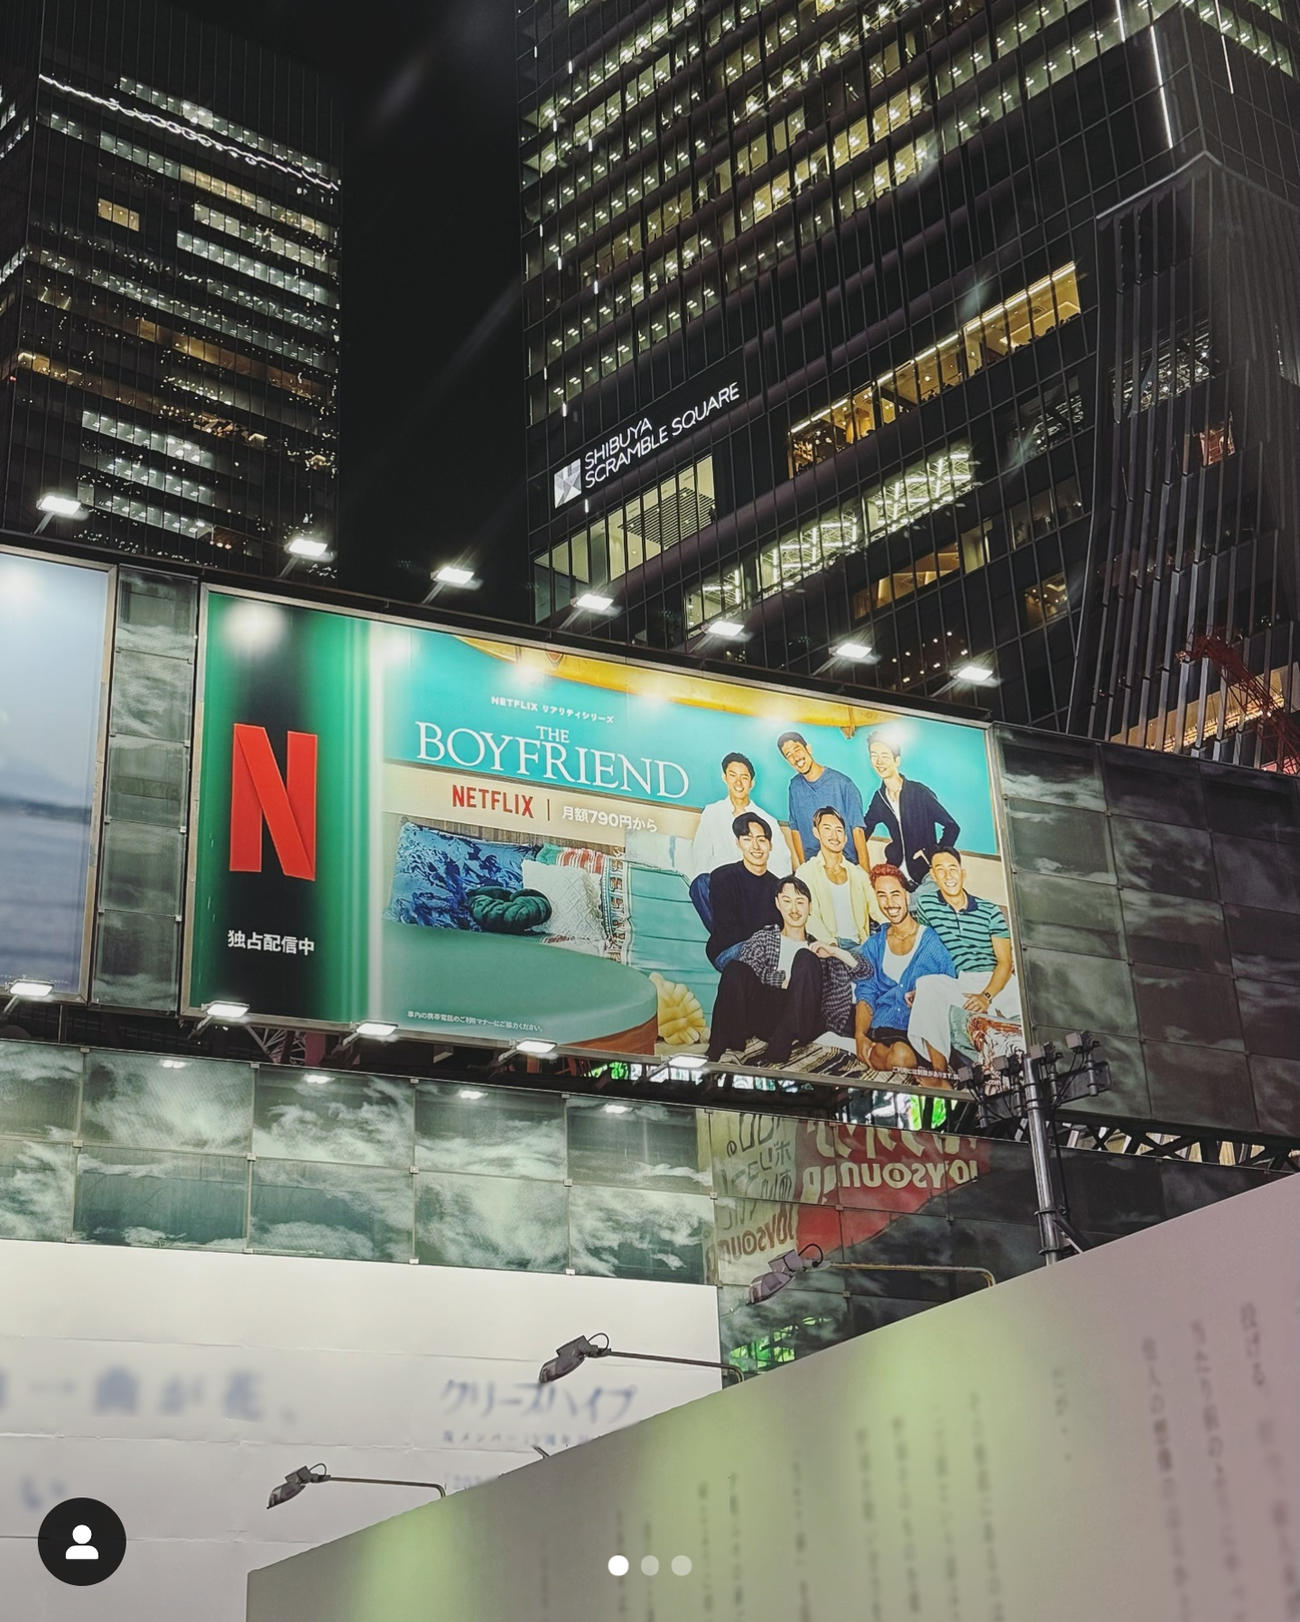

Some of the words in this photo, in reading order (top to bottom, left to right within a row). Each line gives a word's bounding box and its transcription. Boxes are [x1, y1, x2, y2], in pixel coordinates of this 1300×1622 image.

[585, 426, 669, 488] SCRAMBLE
[671, 382, 740, 436] SQUARE
[585, 418, 652, 469] SHIBUYA
[491, 696, 538, 712] NETFLIX
[535, 725, 570, 743] THE
[415, 721, 689, 798] BOYFRIEND
[229, 723, 318, 881] N
[452, 784, 535, 818] NETFLIX
[562, 805, 658, 832] 月額790円から
[227, 929, 315, 956] 独占配信中
